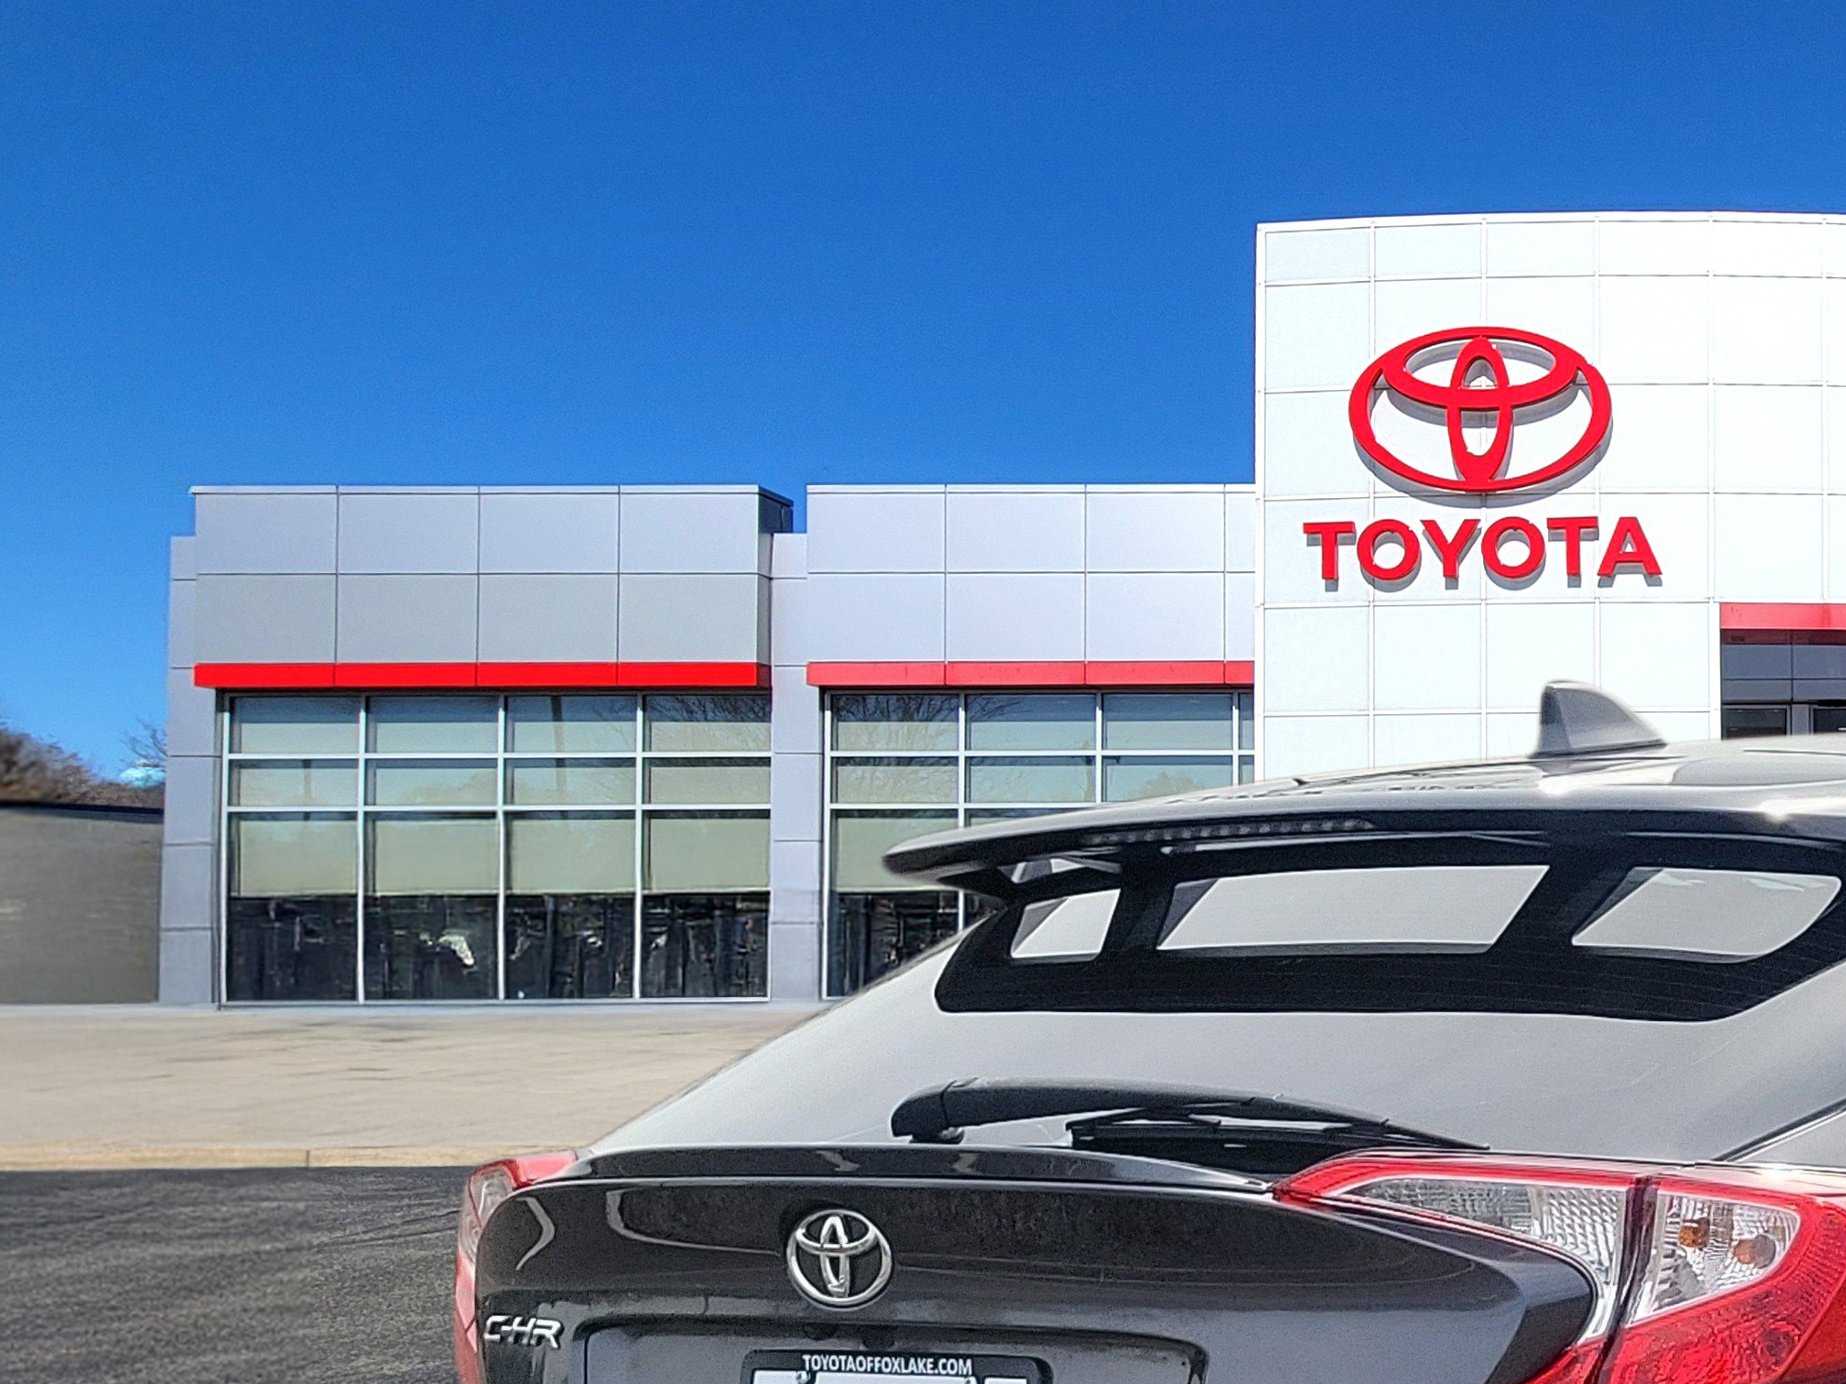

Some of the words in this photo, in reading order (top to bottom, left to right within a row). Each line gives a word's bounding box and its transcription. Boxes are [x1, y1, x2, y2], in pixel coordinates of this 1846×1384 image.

[1303, 516, 1663, 586] TOYOTA
[484, 1314, 562, 1349] C-HR
[802, 1354, 972, 1375] TOYOTAOFFOXLAKE.COM
